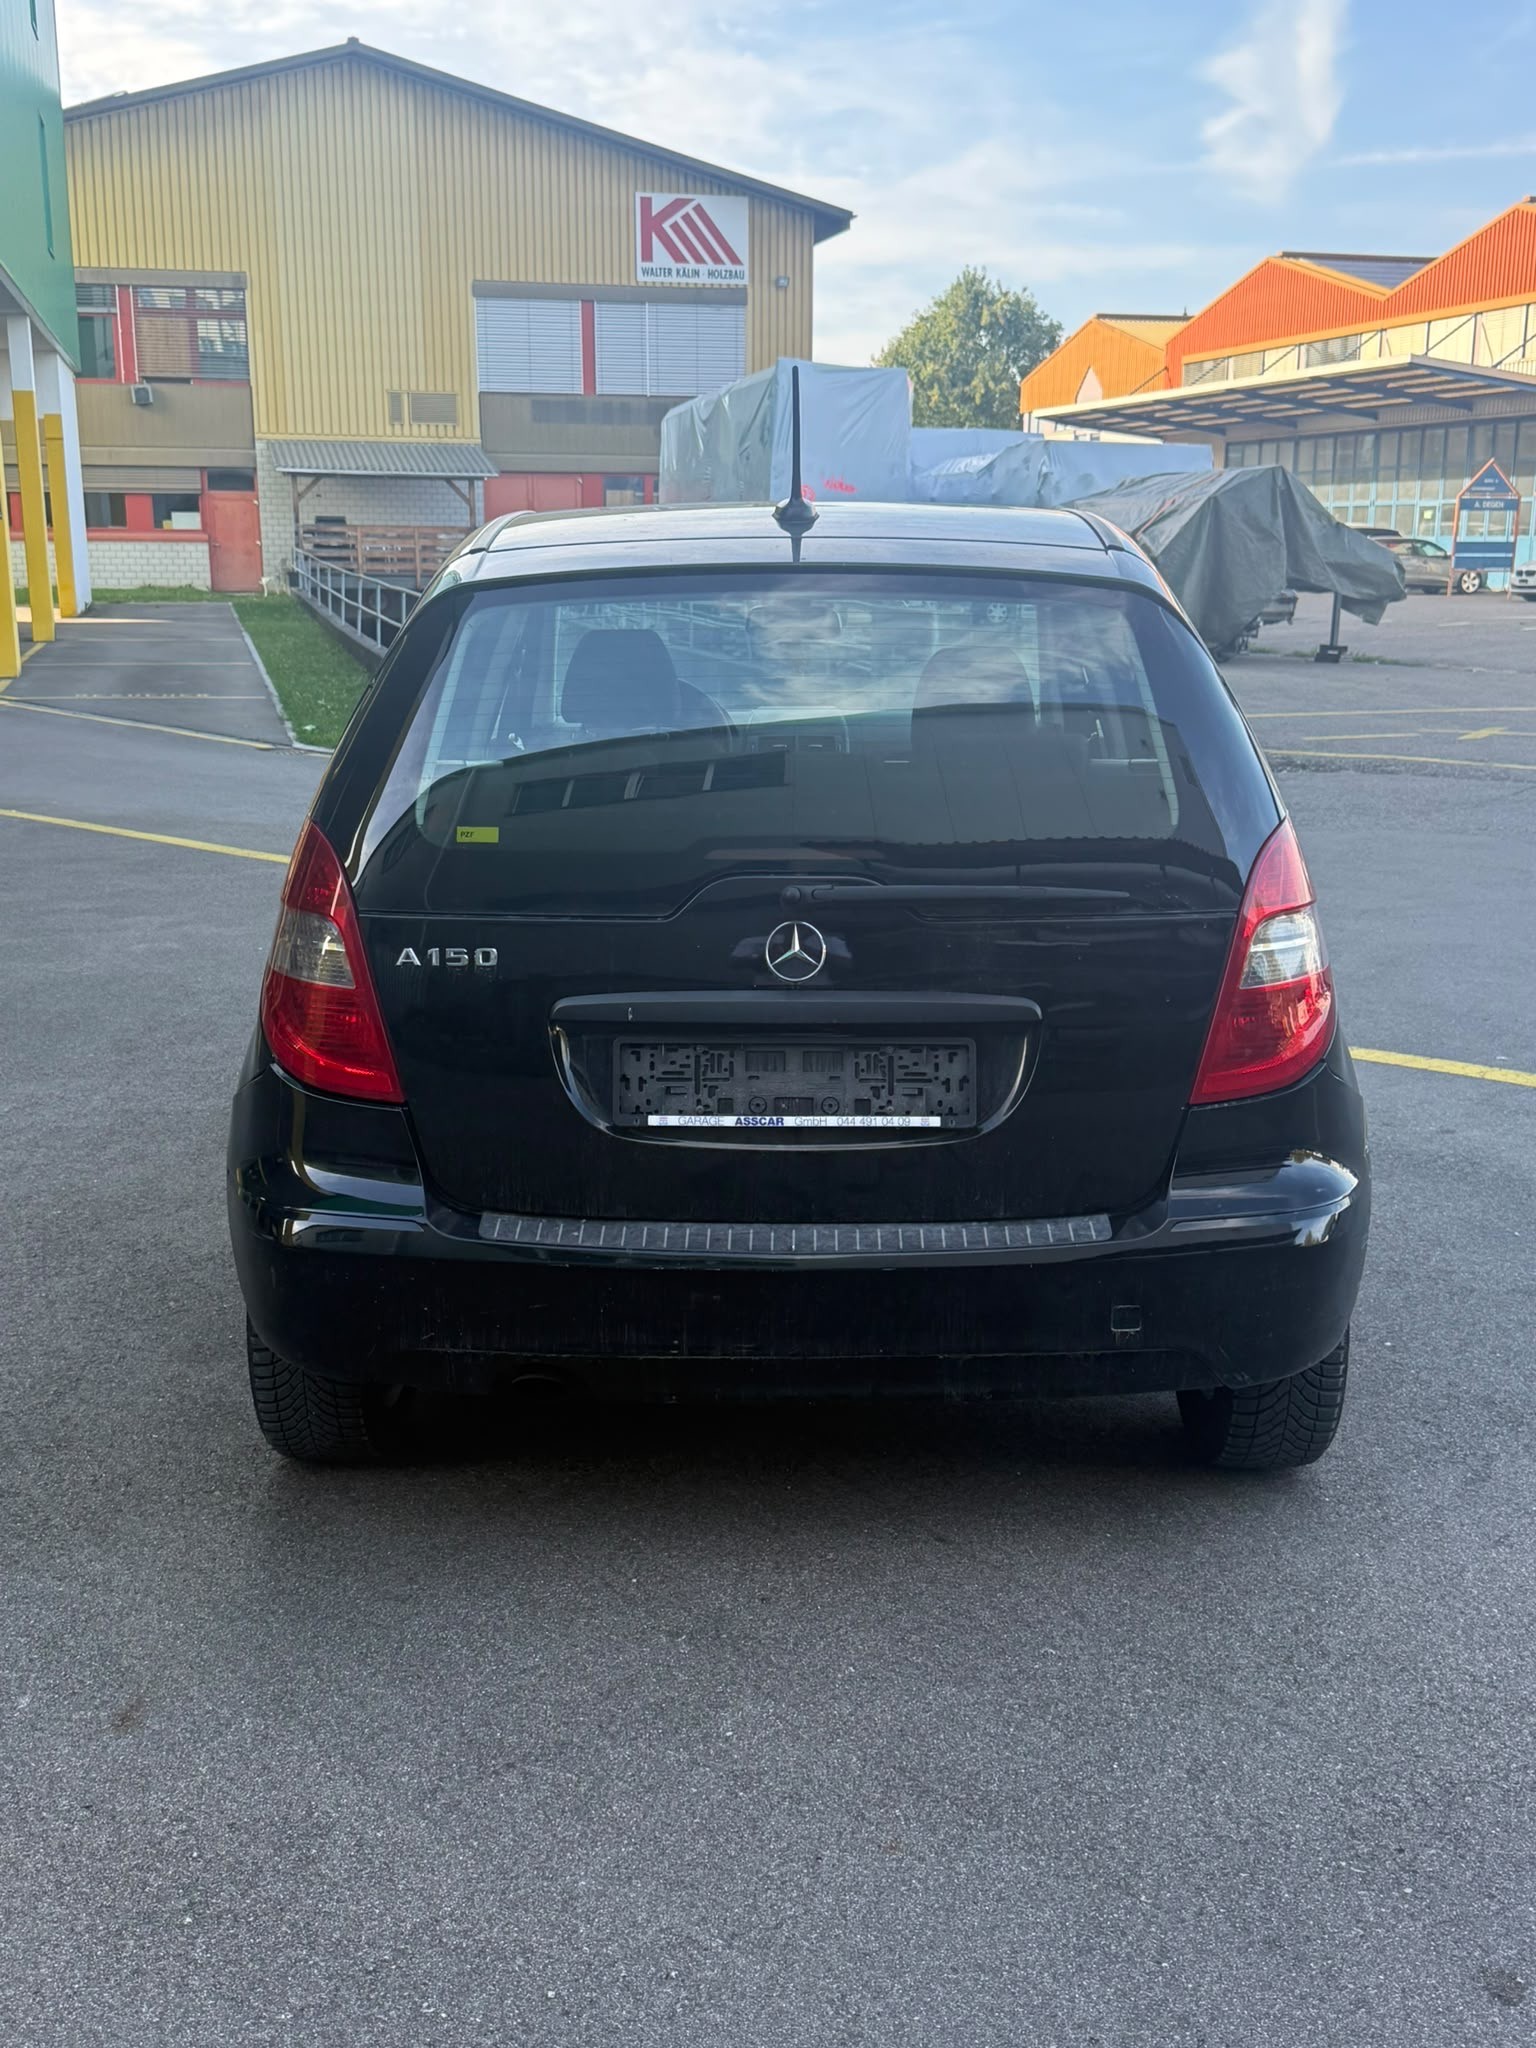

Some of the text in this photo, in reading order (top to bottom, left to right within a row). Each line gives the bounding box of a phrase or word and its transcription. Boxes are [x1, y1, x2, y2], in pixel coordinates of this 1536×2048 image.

[641, 266, 745, 280] WALTER KÄLIN HOLZBAU
[396, 948, 498, 966] A150
[678, 1117, 911, 1127] GARAGE ASSCAR GmbH 044 491 04 09
